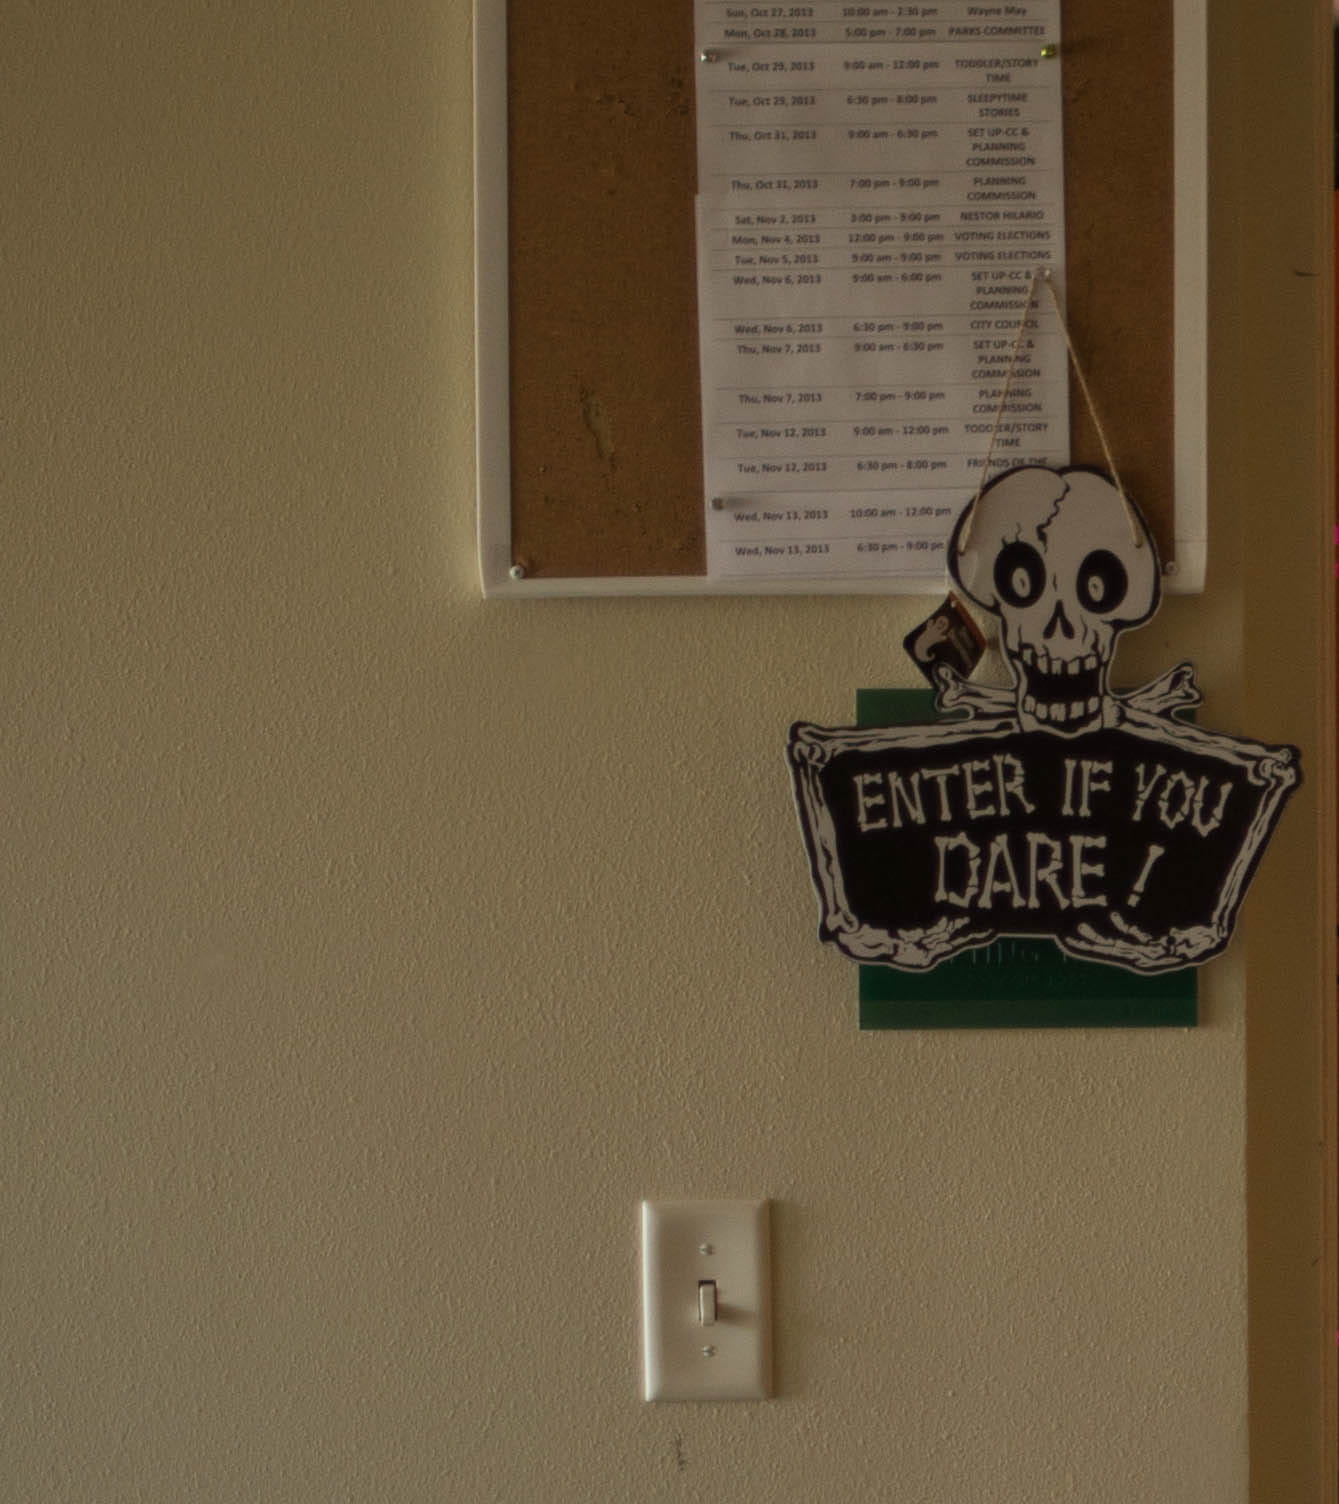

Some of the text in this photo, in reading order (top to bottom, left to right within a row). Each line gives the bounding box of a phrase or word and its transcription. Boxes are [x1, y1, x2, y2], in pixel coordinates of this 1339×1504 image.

[852, 753, 1233, 837] ENTER IF YOU
